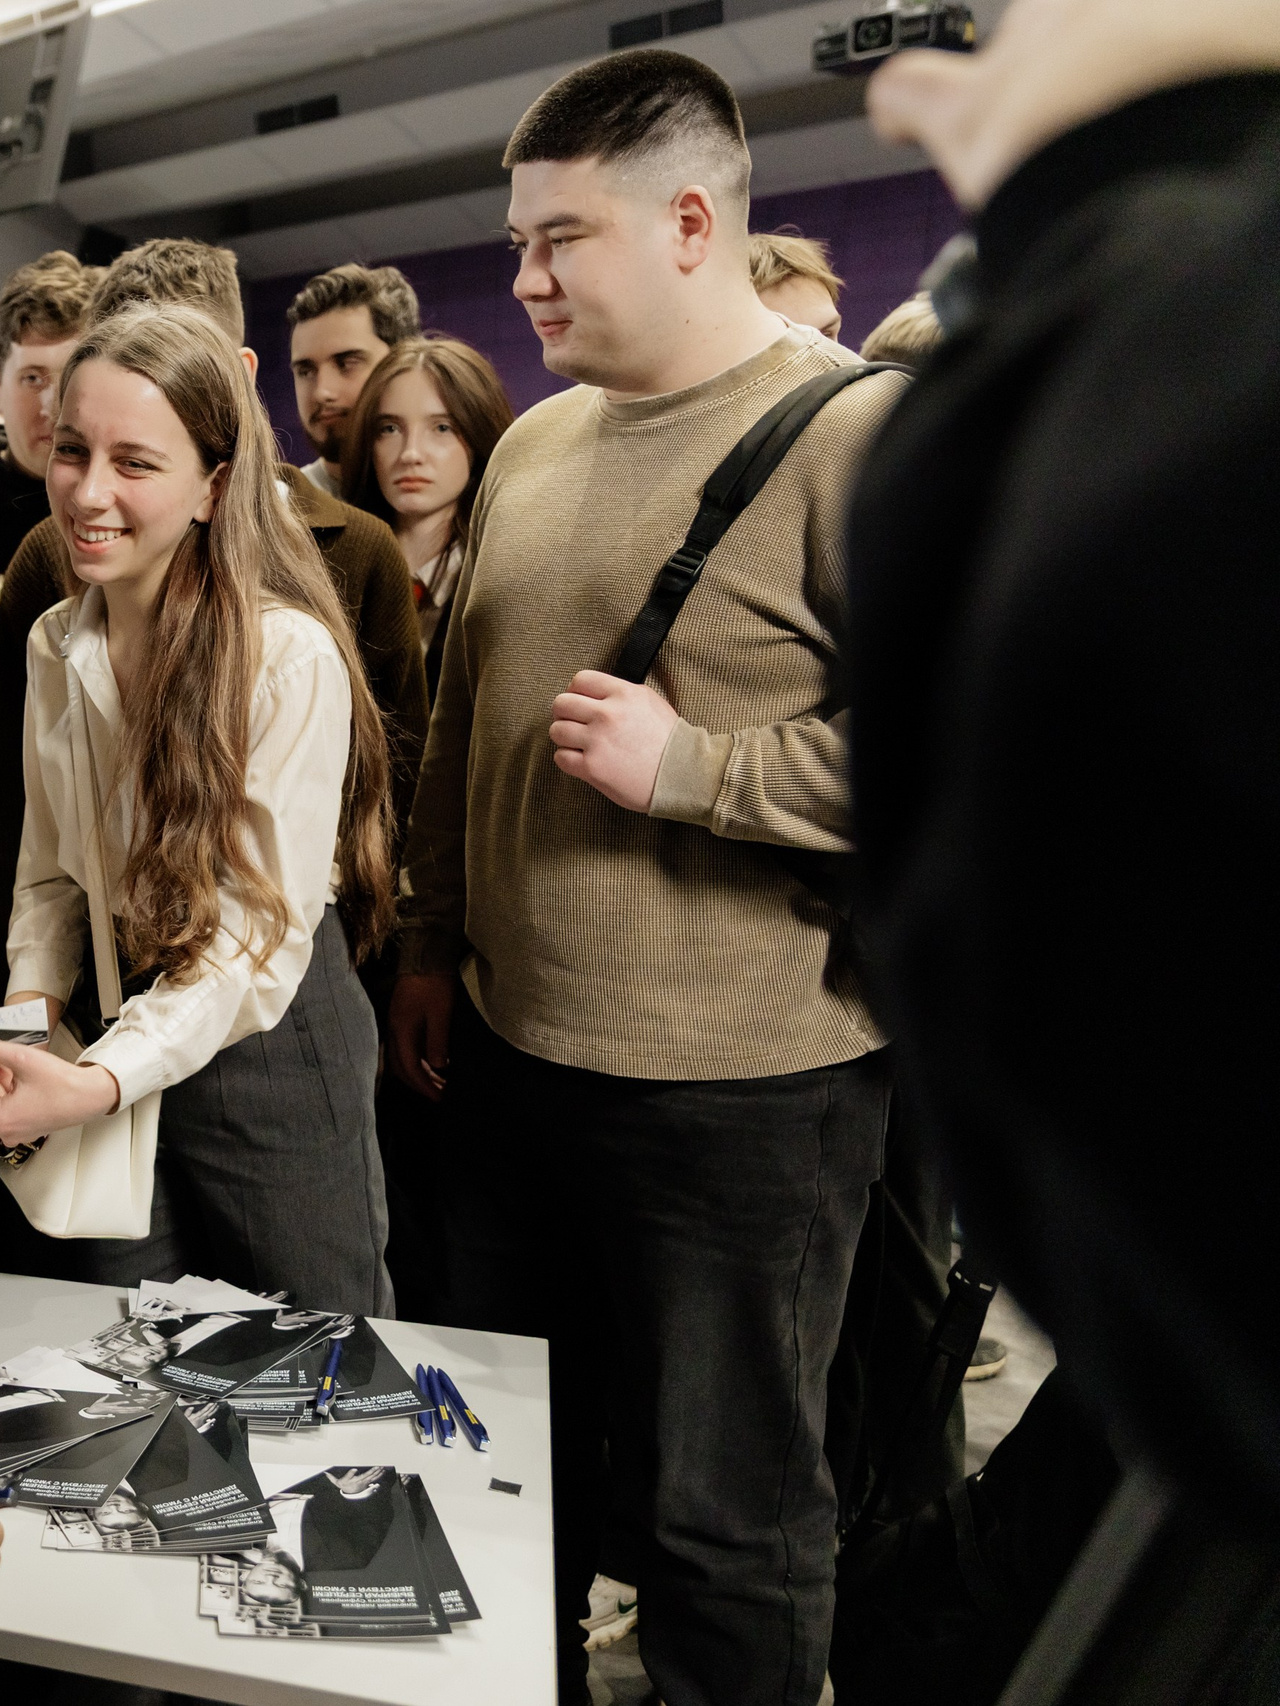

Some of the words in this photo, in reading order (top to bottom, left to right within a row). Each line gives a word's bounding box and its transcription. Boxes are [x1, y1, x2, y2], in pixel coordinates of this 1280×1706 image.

[370, 1390, 413, 1401] ДЕЙСТВУЙ
[376, 1394, 416, 1403] ВЫБИРАЙ
[19, 1482, 62, 1491] СЕРДЦЕМ!
[22, 1477, 52, 1485] УМОМ!
[61, 1481, 108, 1489] ДЕЙСТВУЙ
[191, 1483, 237, 1500] ДЕЙСТВУЙ
[198, 1489, 241, 1504] ВЫБИРАЙ
[152, 1499, 181, 1510] УМОМ!
[155, 1500, 199, 1514] СЕРДЦЕМ!
